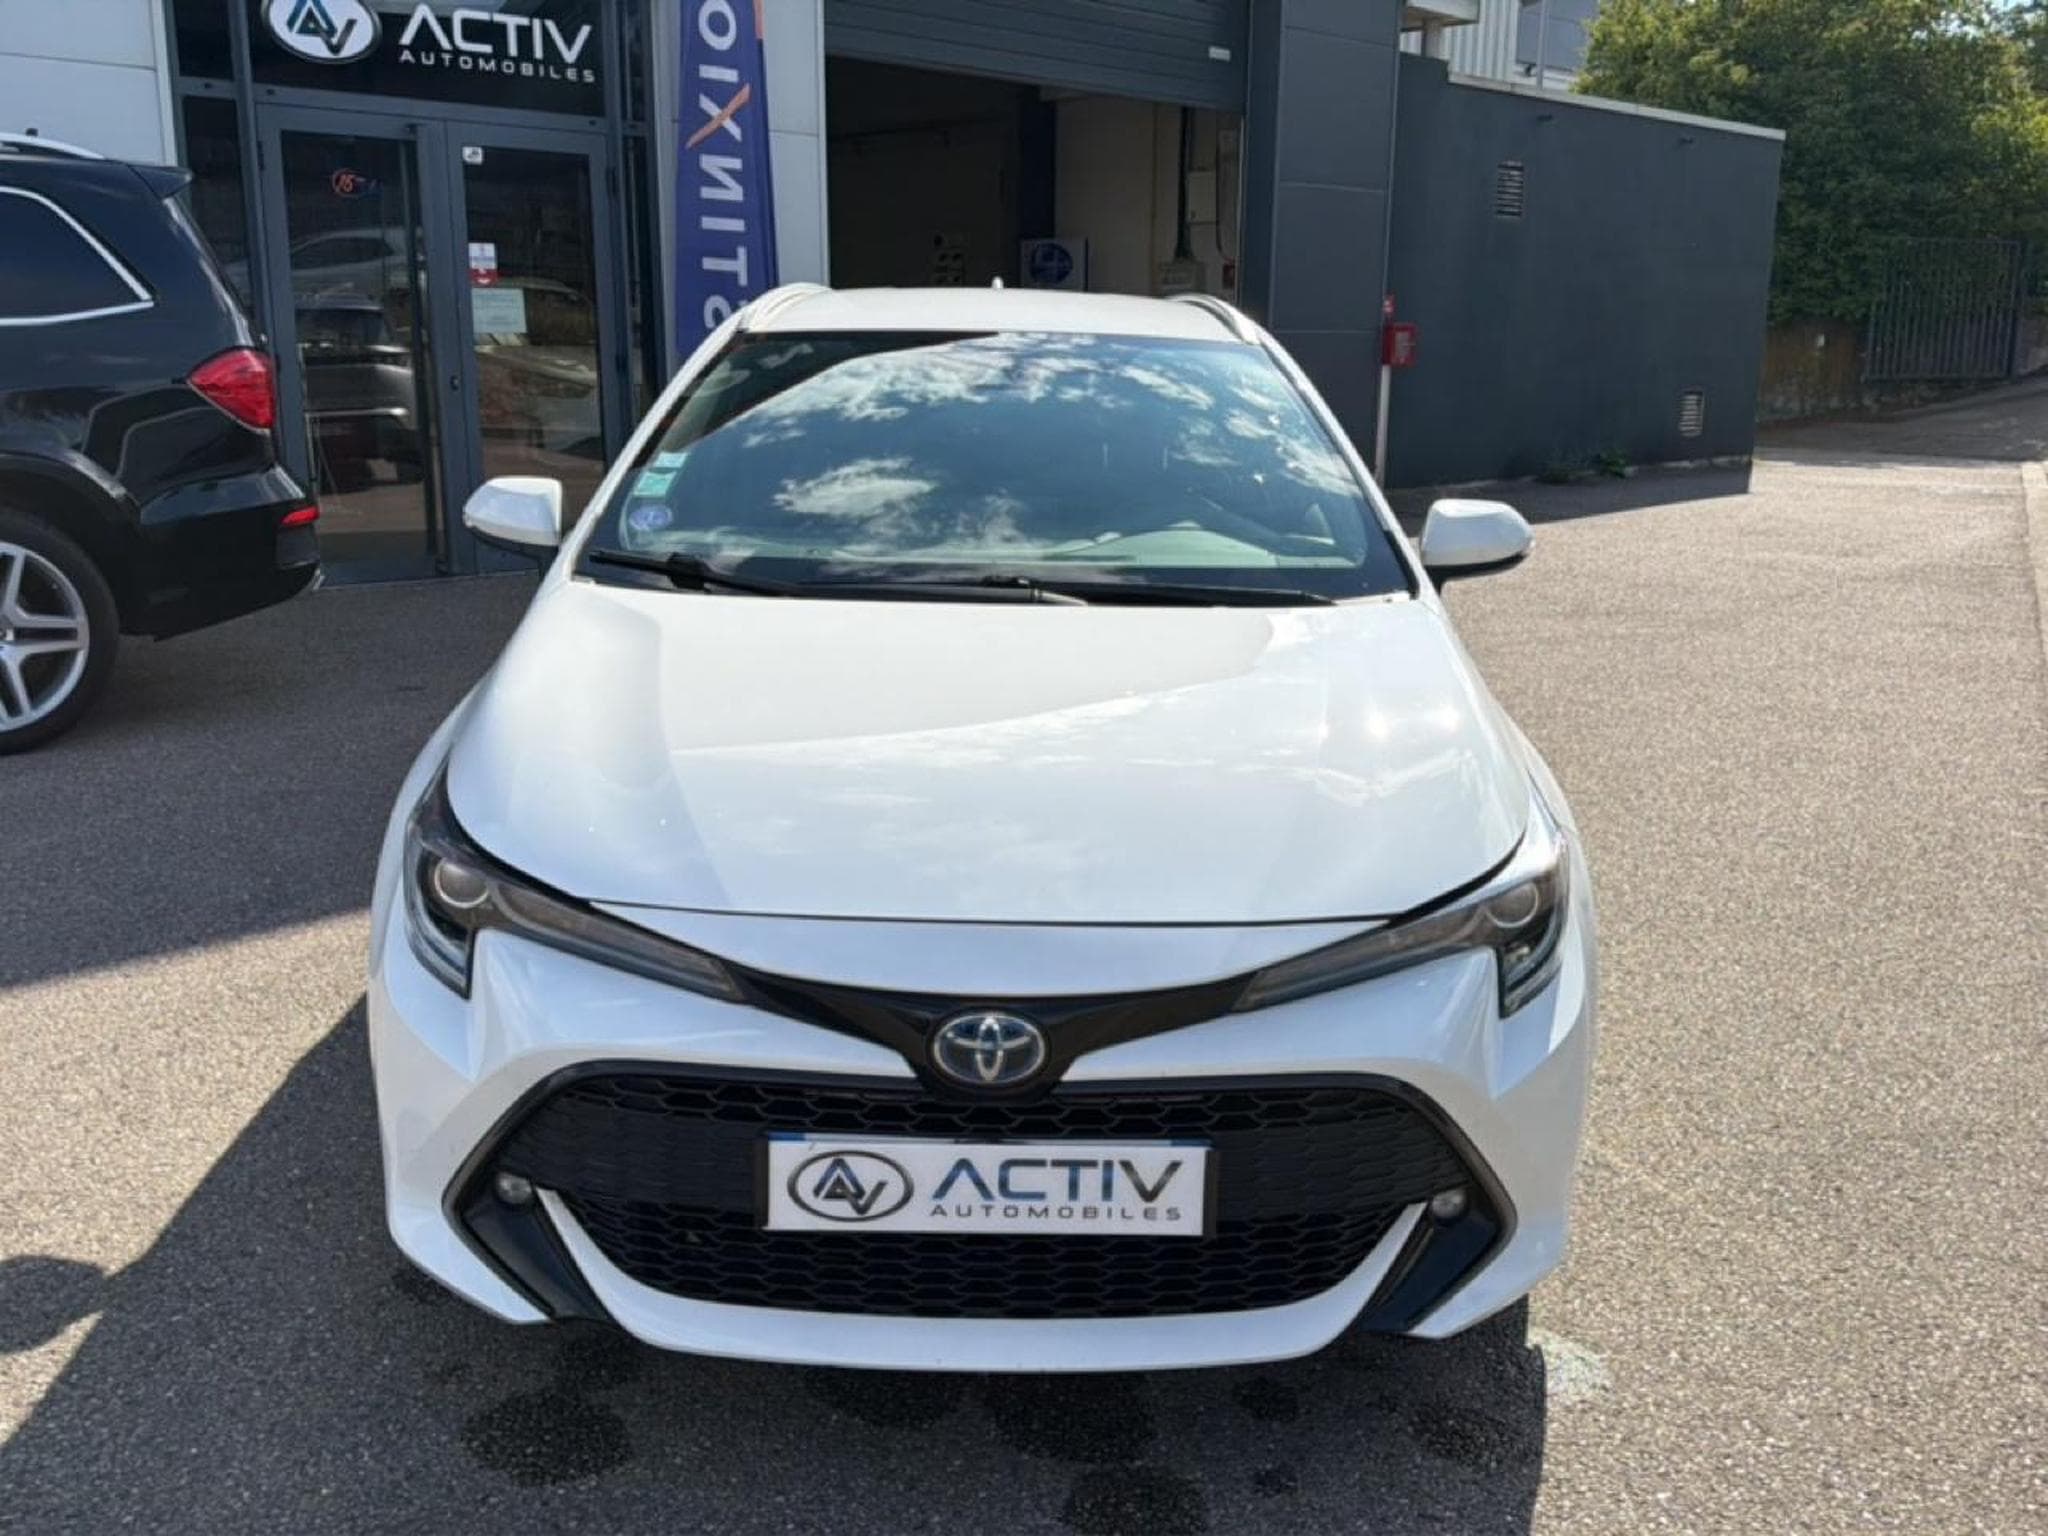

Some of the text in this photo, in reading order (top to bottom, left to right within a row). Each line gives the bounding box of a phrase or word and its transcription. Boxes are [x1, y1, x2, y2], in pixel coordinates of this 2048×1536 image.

[399, 3, 592, 64] ACTIV
[399, 50, 595, 83] AUTOMOBILES
[932, 1158, 1183, 1201] ACTIV
[930, 1204, 1181, 1220] AUTOMOBILES
